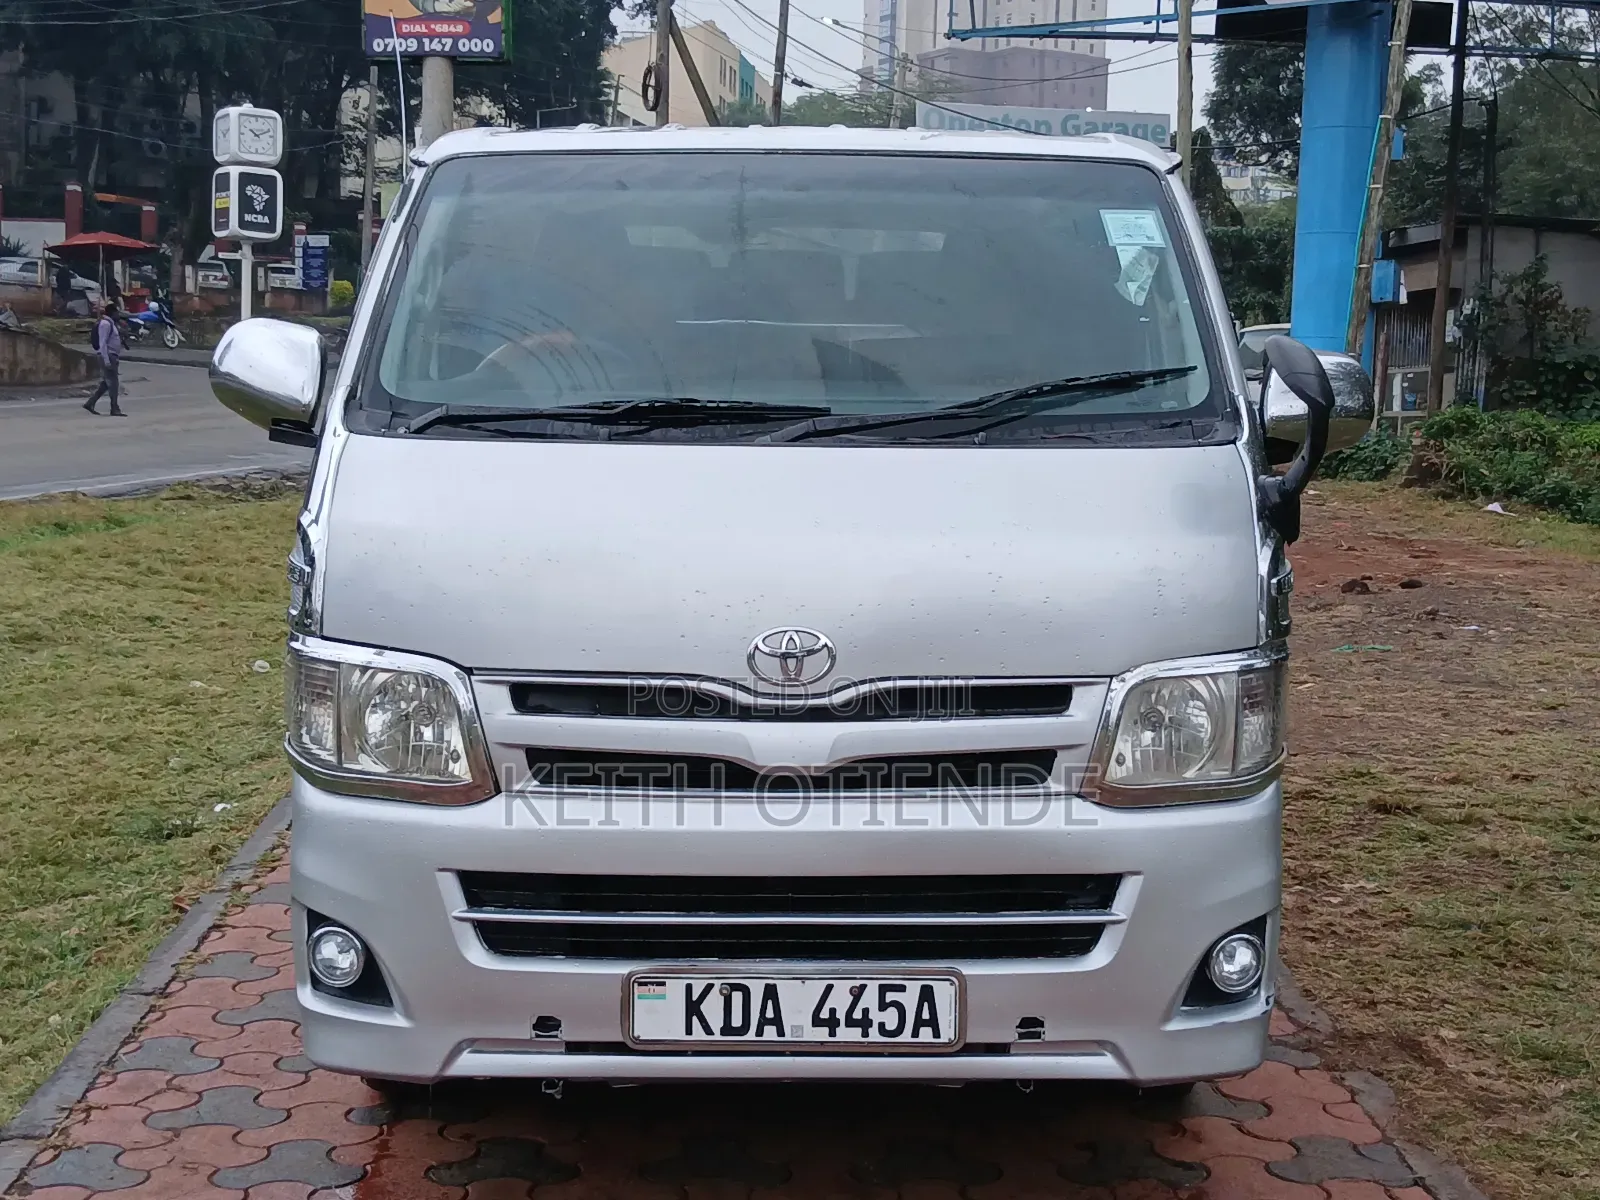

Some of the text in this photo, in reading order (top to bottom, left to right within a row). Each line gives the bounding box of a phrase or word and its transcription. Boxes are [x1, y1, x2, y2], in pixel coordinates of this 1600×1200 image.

[402, 24, 428, 33] DIAL
[372, 38, 495, 53] 0709 147 000
[1061, 113, 1167, 143] Garage
[244, 213, 270, 224] NCBA
[684, 982, 786, 1038] KDA
[811, 982, 942, 1039] 445A
